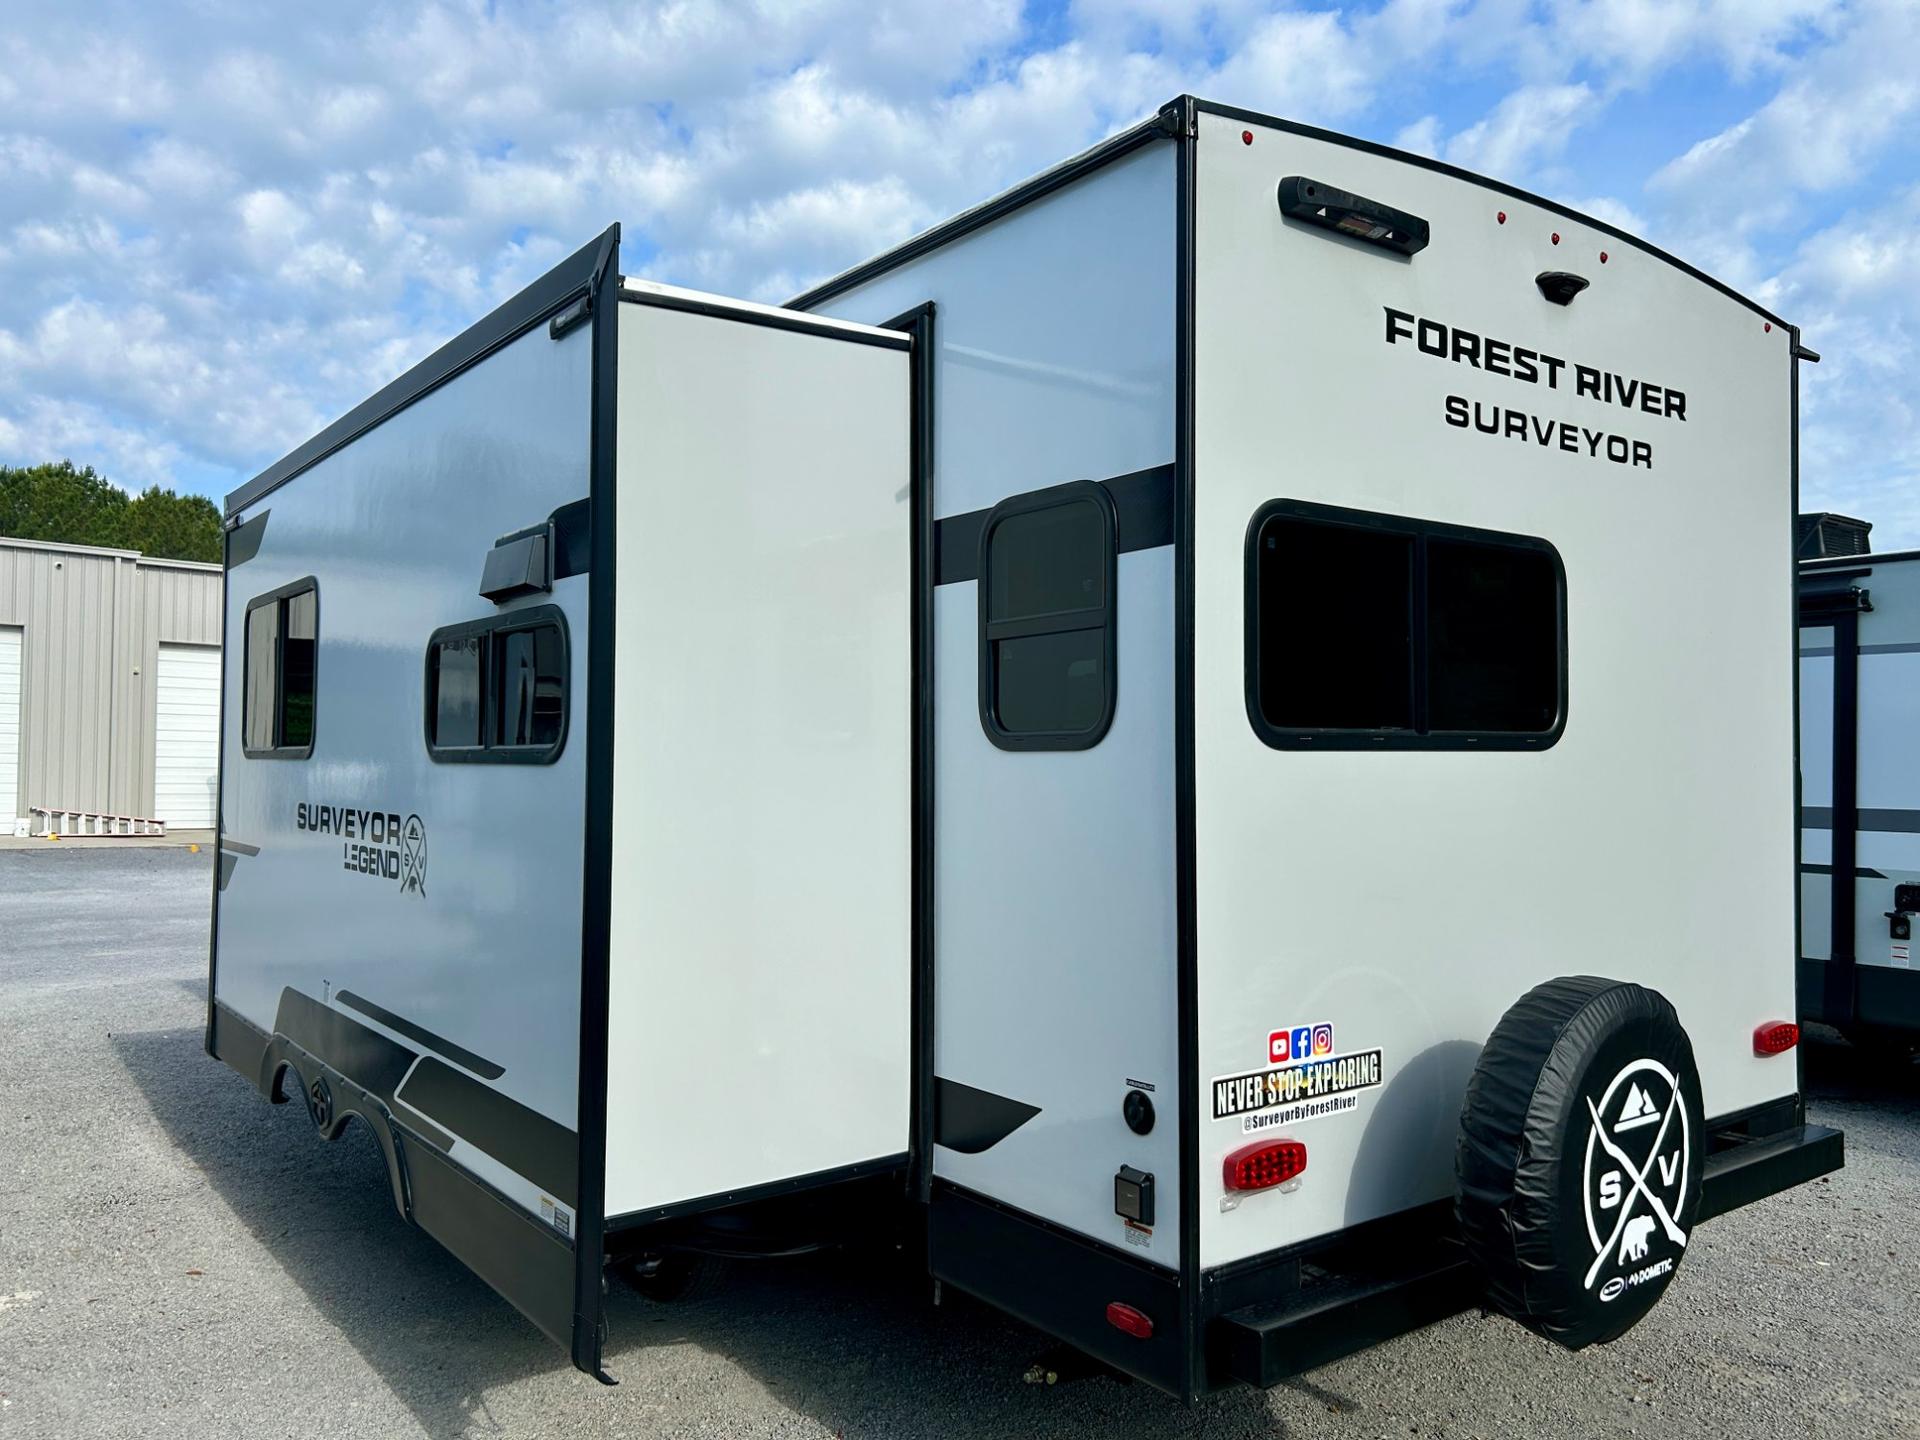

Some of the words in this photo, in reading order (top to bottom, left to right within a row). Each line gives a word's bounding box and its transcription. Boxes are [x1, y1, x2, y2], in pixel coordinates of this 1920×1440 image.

[1383, 306, 1565, 389] FOREST
[1574, 363, 1686, 421] RIVER
[1445, 395, 1652, 469] SURVEYOR
[297, 802, 400, 846] SURVEYOR
[344, 842, 399, 879] LEGEND
[1217, 1076, 1263, 1115] NEVER
[1267, 1066, 1302, 1104] STOP
[1307, 1053, 1378, 1097] EXPLORING
[1244, 1096, 1356, 1131] @SurveyorByForestRiver
[1600, 1170, 1621, 1209] S
[1658, 1150, 1679, 1186] V
[1639, 1257, 1673, 1284] DOMETIC
